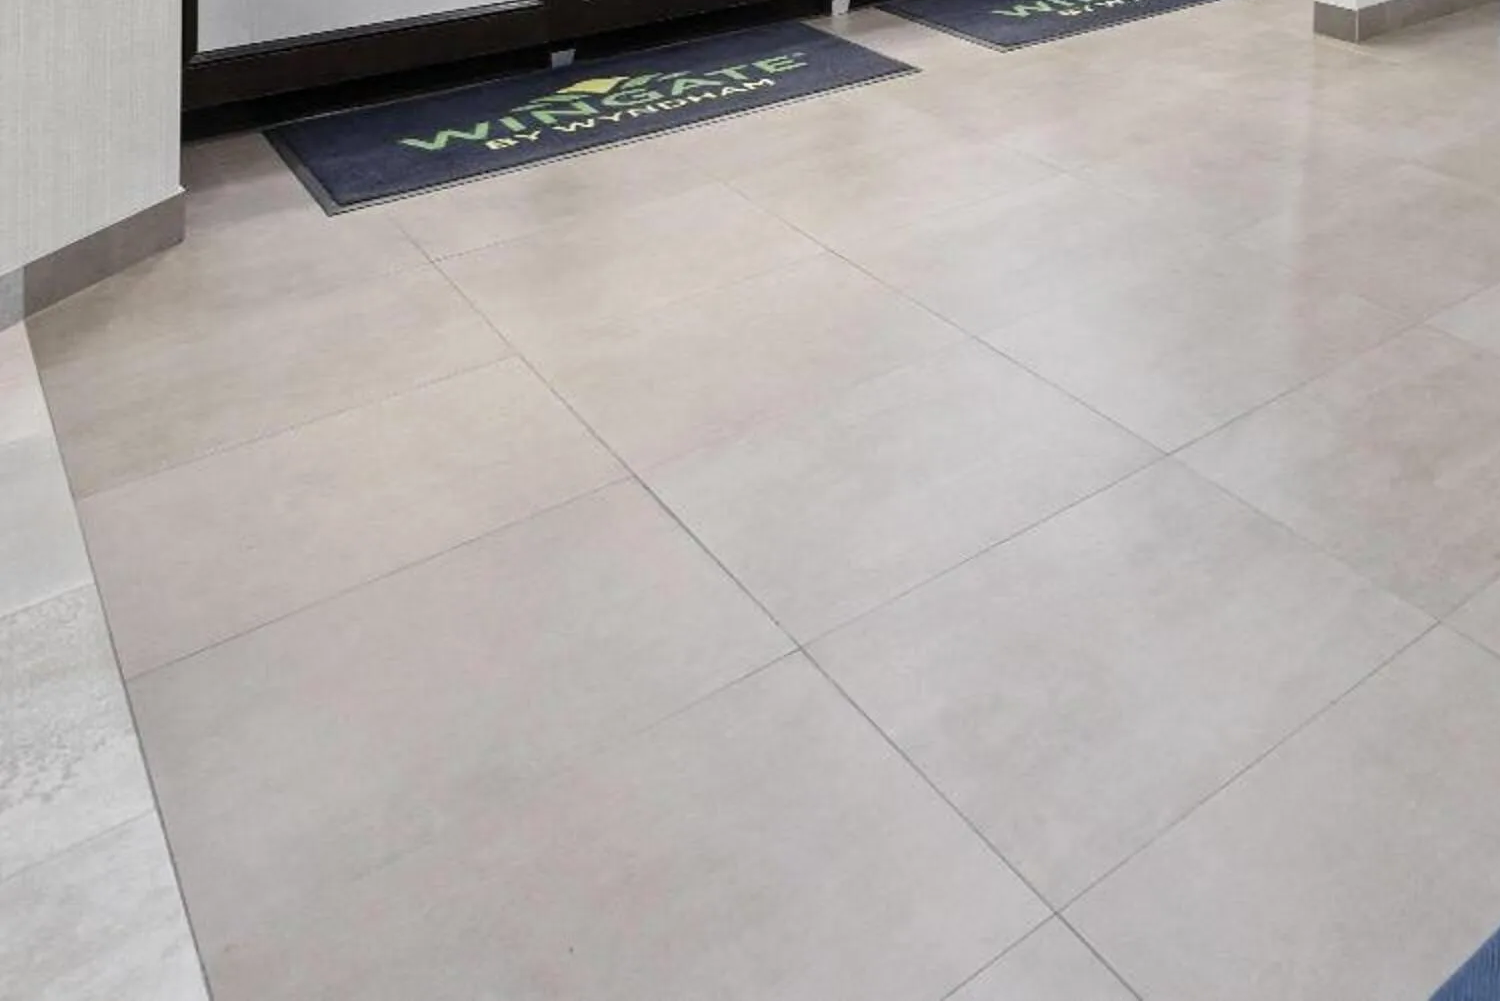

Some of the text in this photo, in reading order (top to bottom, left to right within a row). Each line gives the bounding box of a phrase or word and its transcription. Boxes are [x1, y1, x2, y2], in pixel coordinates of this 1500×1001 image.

[399, 52, 808, 150] WINGATE
[485, 77, 776, 150] BY WYNDHAM
